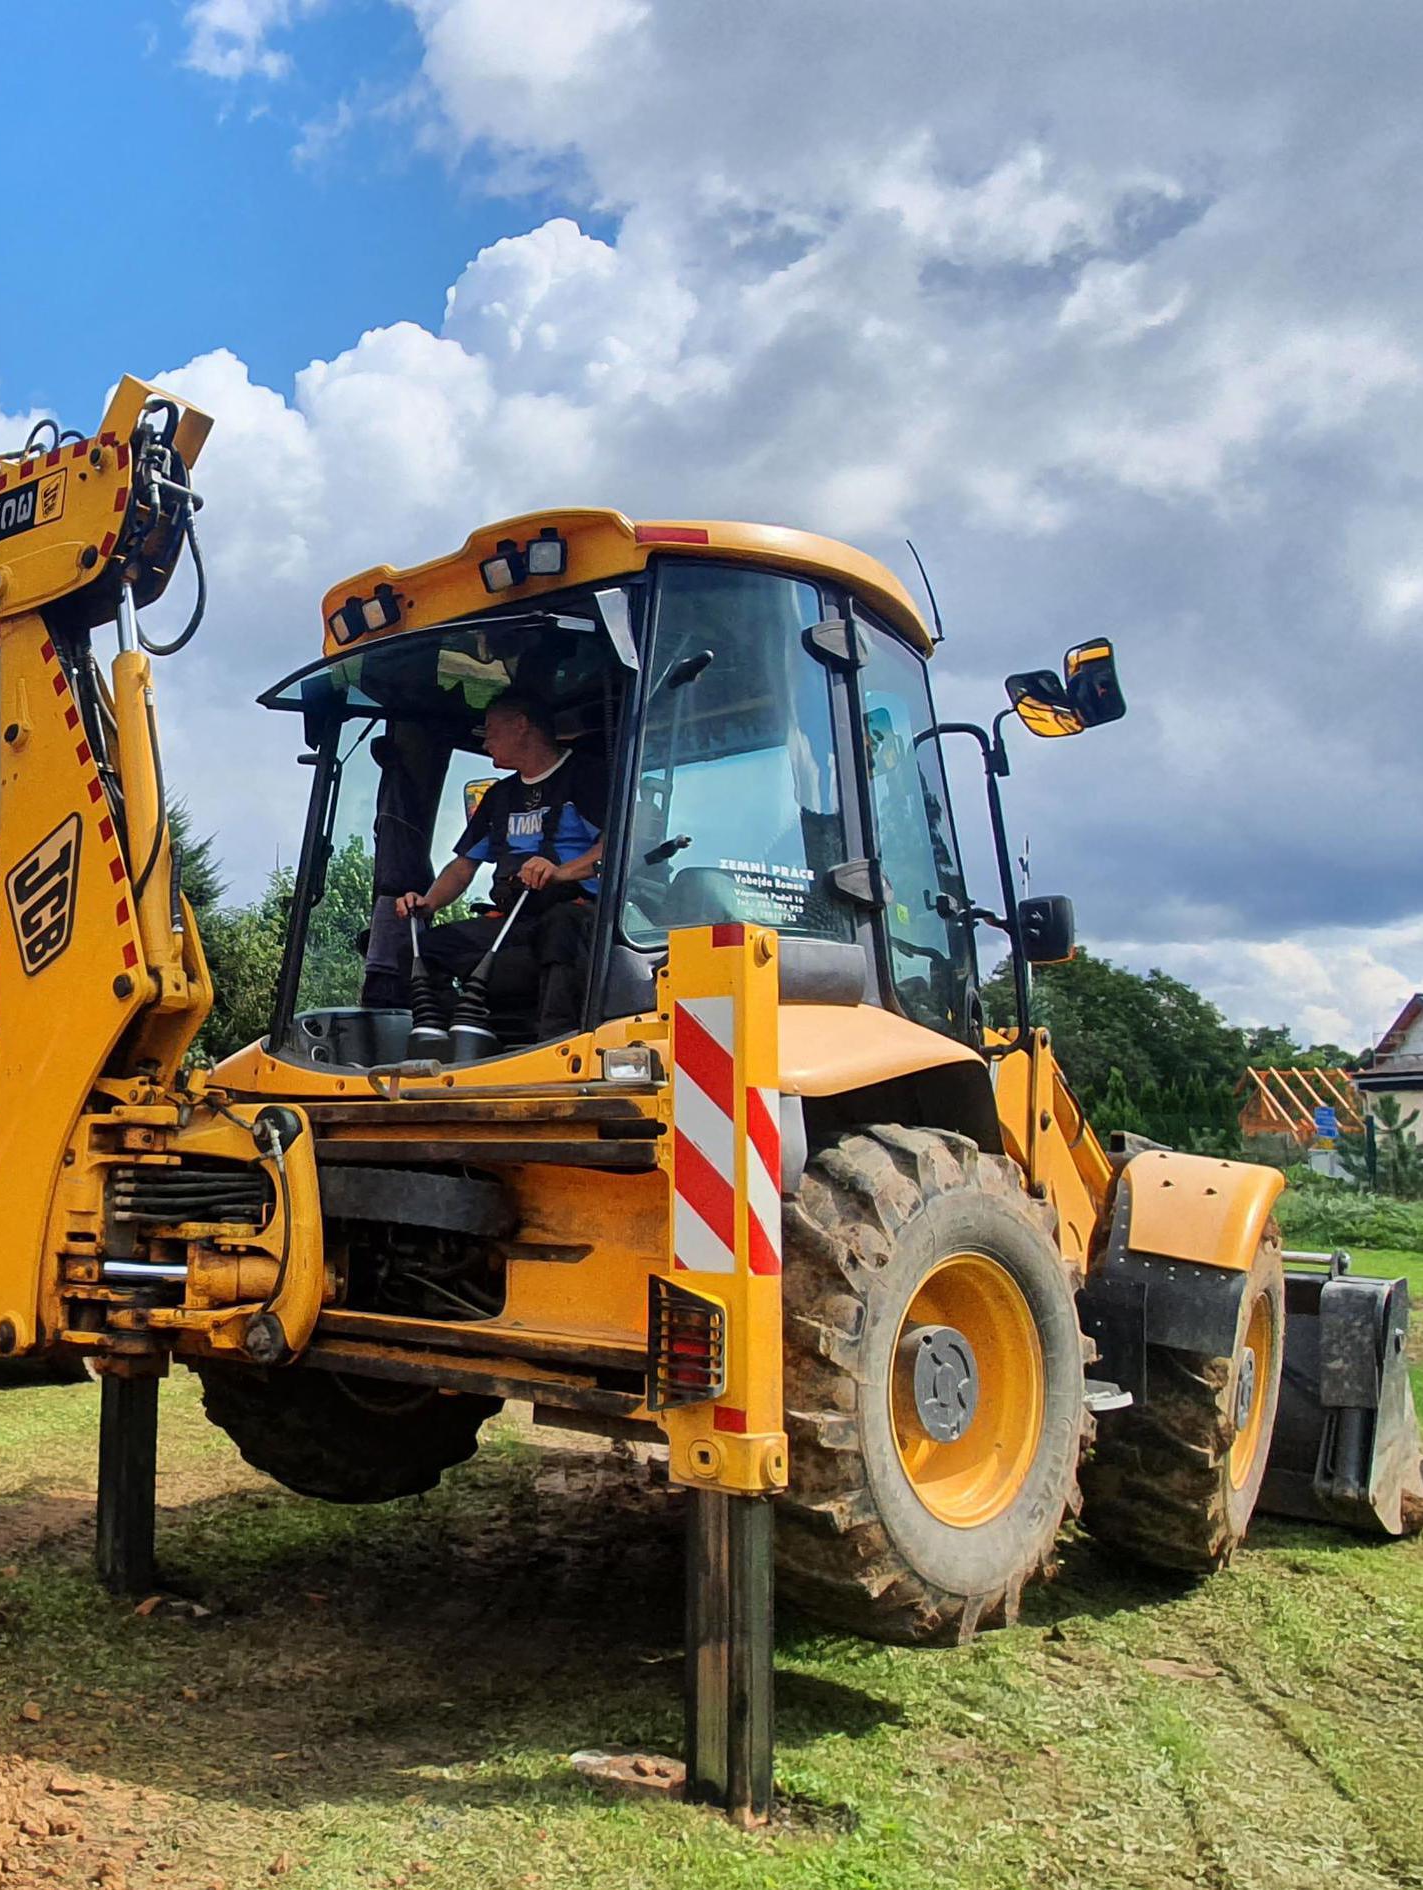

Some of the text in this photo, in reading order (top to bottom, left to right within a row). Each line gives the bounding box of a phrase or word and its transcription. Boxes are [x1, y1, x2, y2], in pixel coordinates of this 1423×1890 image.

[13, 839, 73, 965] JCB
[720, 859, 815, 880] ZEMNÍ PRÁCE
